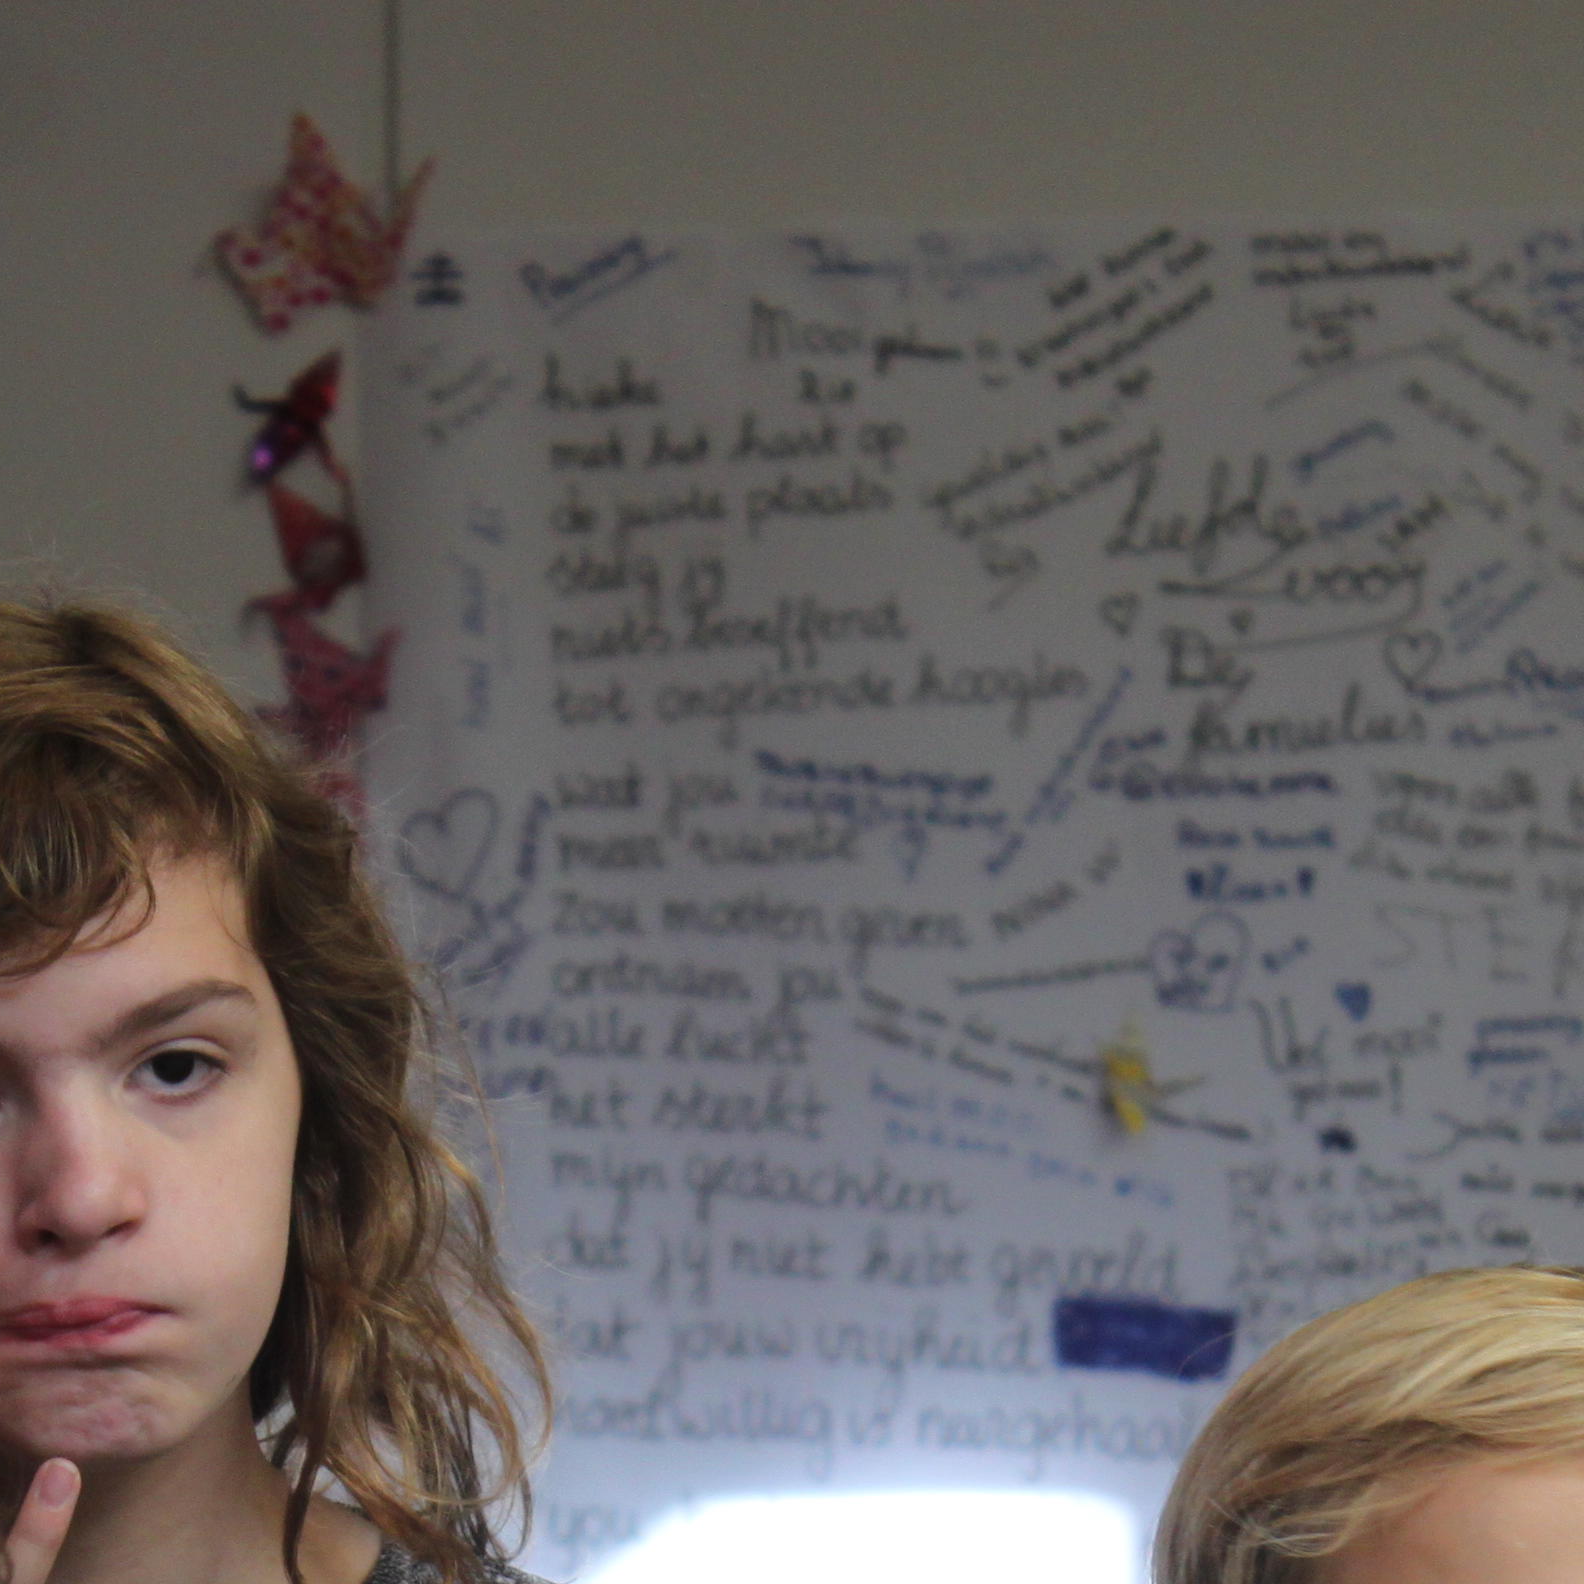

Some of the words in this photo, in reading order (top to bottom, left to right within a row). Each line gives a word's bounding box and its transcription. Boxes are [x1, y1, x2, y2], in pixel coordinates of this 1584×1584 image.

[747, 467, 894, 538] plaats
[551, 677, 632, 727] tot
[550, 950, 752, 1002] ontnam
[547, 1006, 646, 1060] alle
[682, 1150, 972, 1224] gedachten
